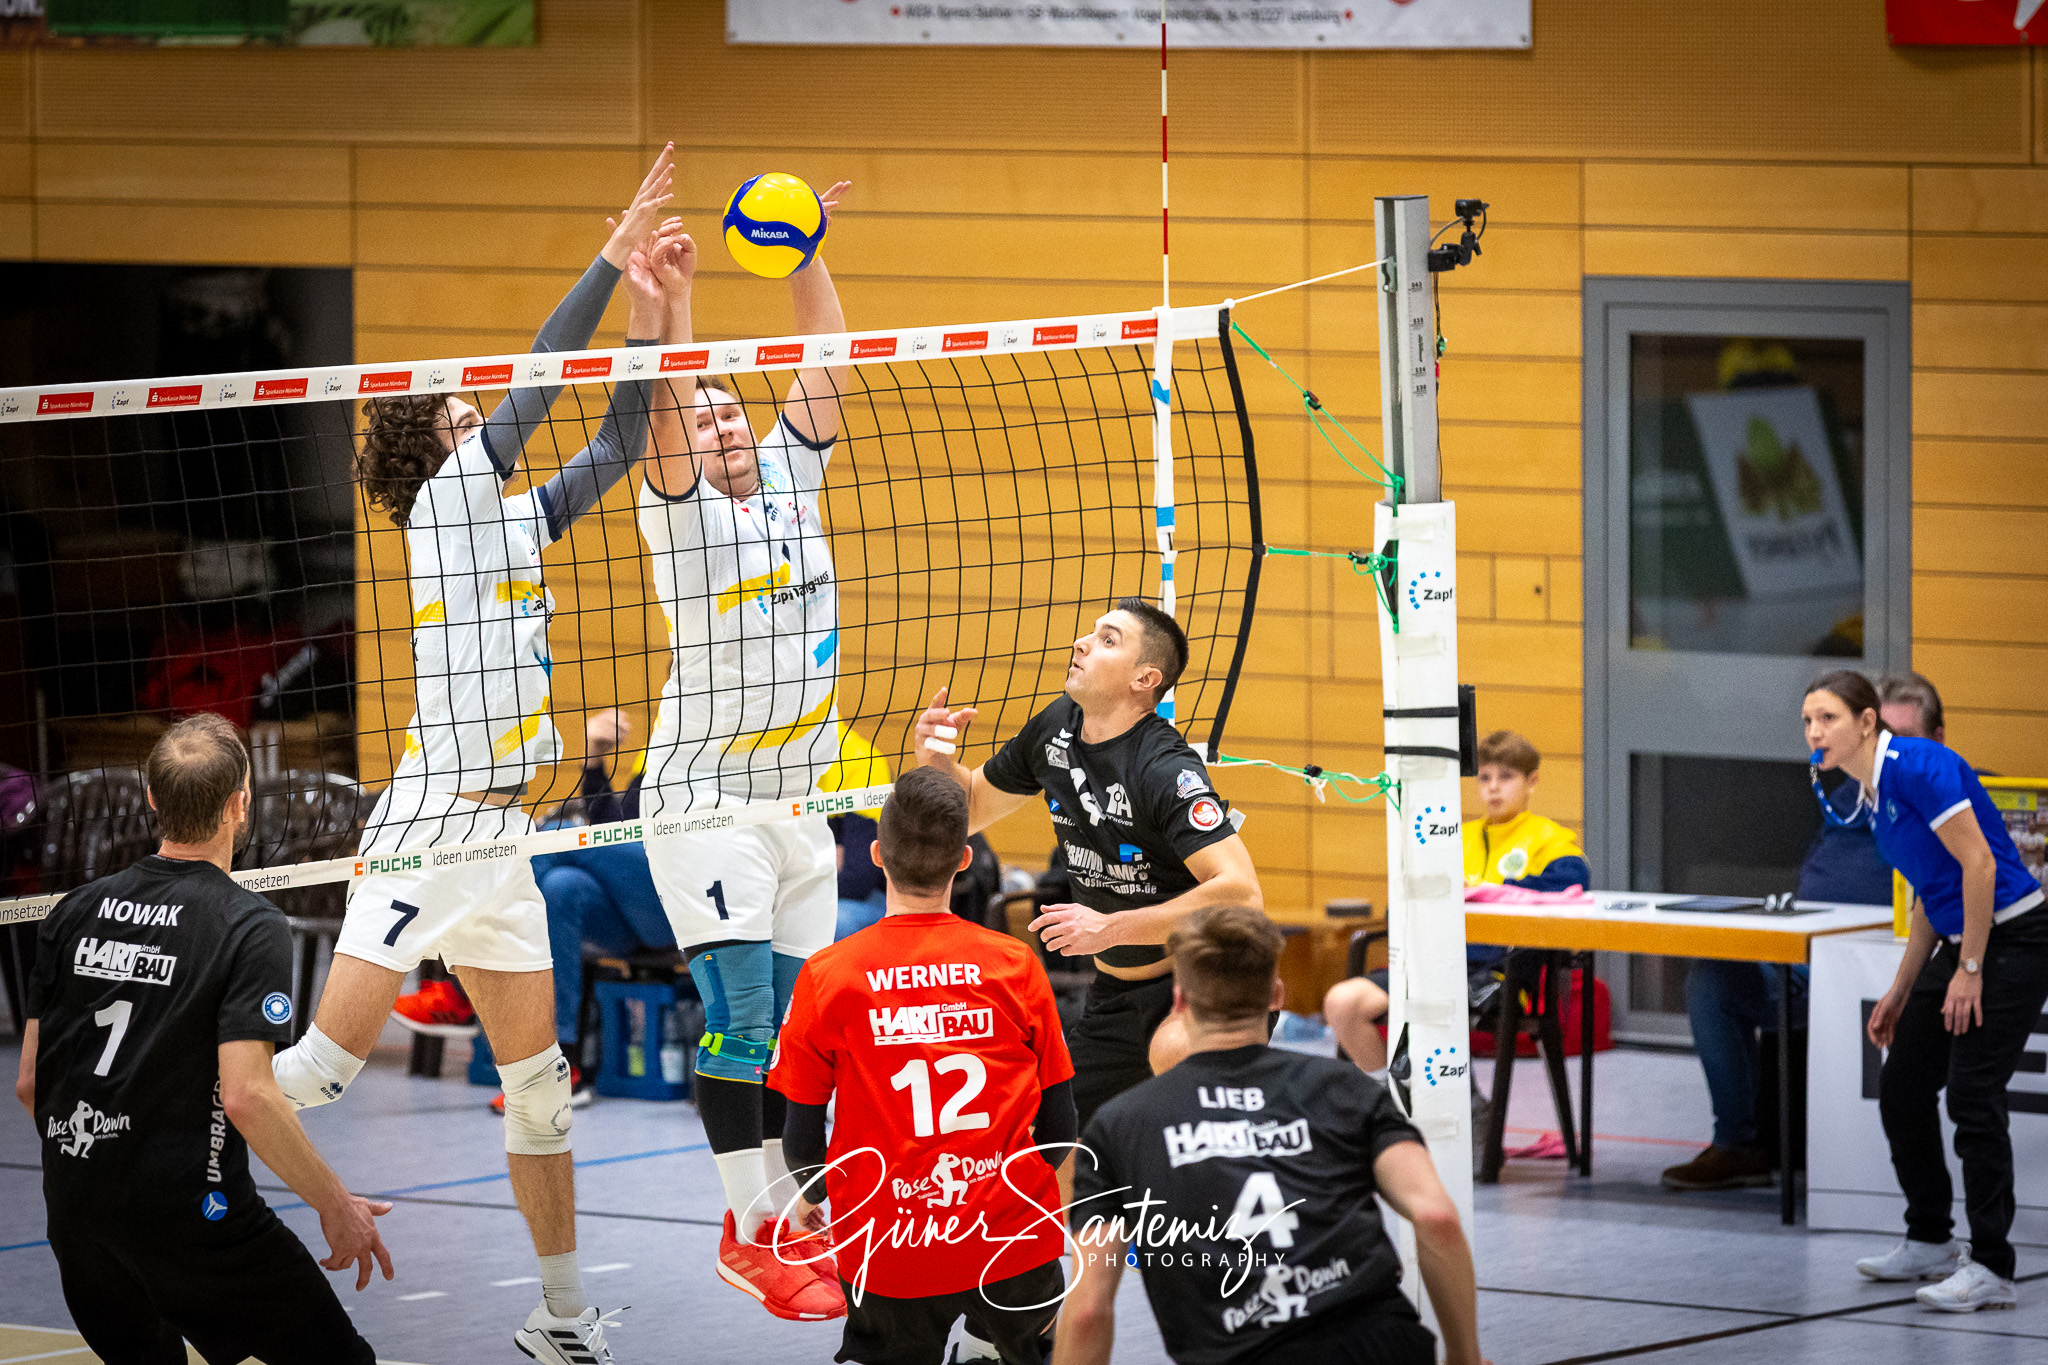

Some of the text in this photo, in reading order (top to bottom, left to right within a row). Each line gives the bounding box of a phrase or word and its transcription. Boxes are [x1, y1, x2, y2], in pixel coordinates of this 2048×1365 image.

[6, 405, 19, 413] Zapf
[224, 391, 237, 399] Zapf
[806, 796, 854, 814] FUCHS
[593, 815, 734, 845] FUCHS Ideen umsetzen
[370, 843, 517, 874] FUCHS Ideen umsetzen
[97, 897, 184, 927] NOWAK
[706, 880, 730, 920] 1
[383, 899, 420, 947] 7
[74, 937, 142, 972] HART
[131, 955, 173, 981] BAU
[866, 963, 982, 992] WERNER
[868, 1004, 941, 1036] HART
[941, 1002, 967, 1012] GmbH
[94, 1000, 133, 1077] 1
[942, 1012, 989, 1038] BAU
[890, 1053, 990, 1137] 12
[1197, 1086, 1266, 1112] LIEB
[93, 1110, 131, 1135] Down
[1162, 1118, 1250, 1155] HART
[891, 1176, 932, 1200] Pose
[1225, 1171, 1299, 1249] 4
